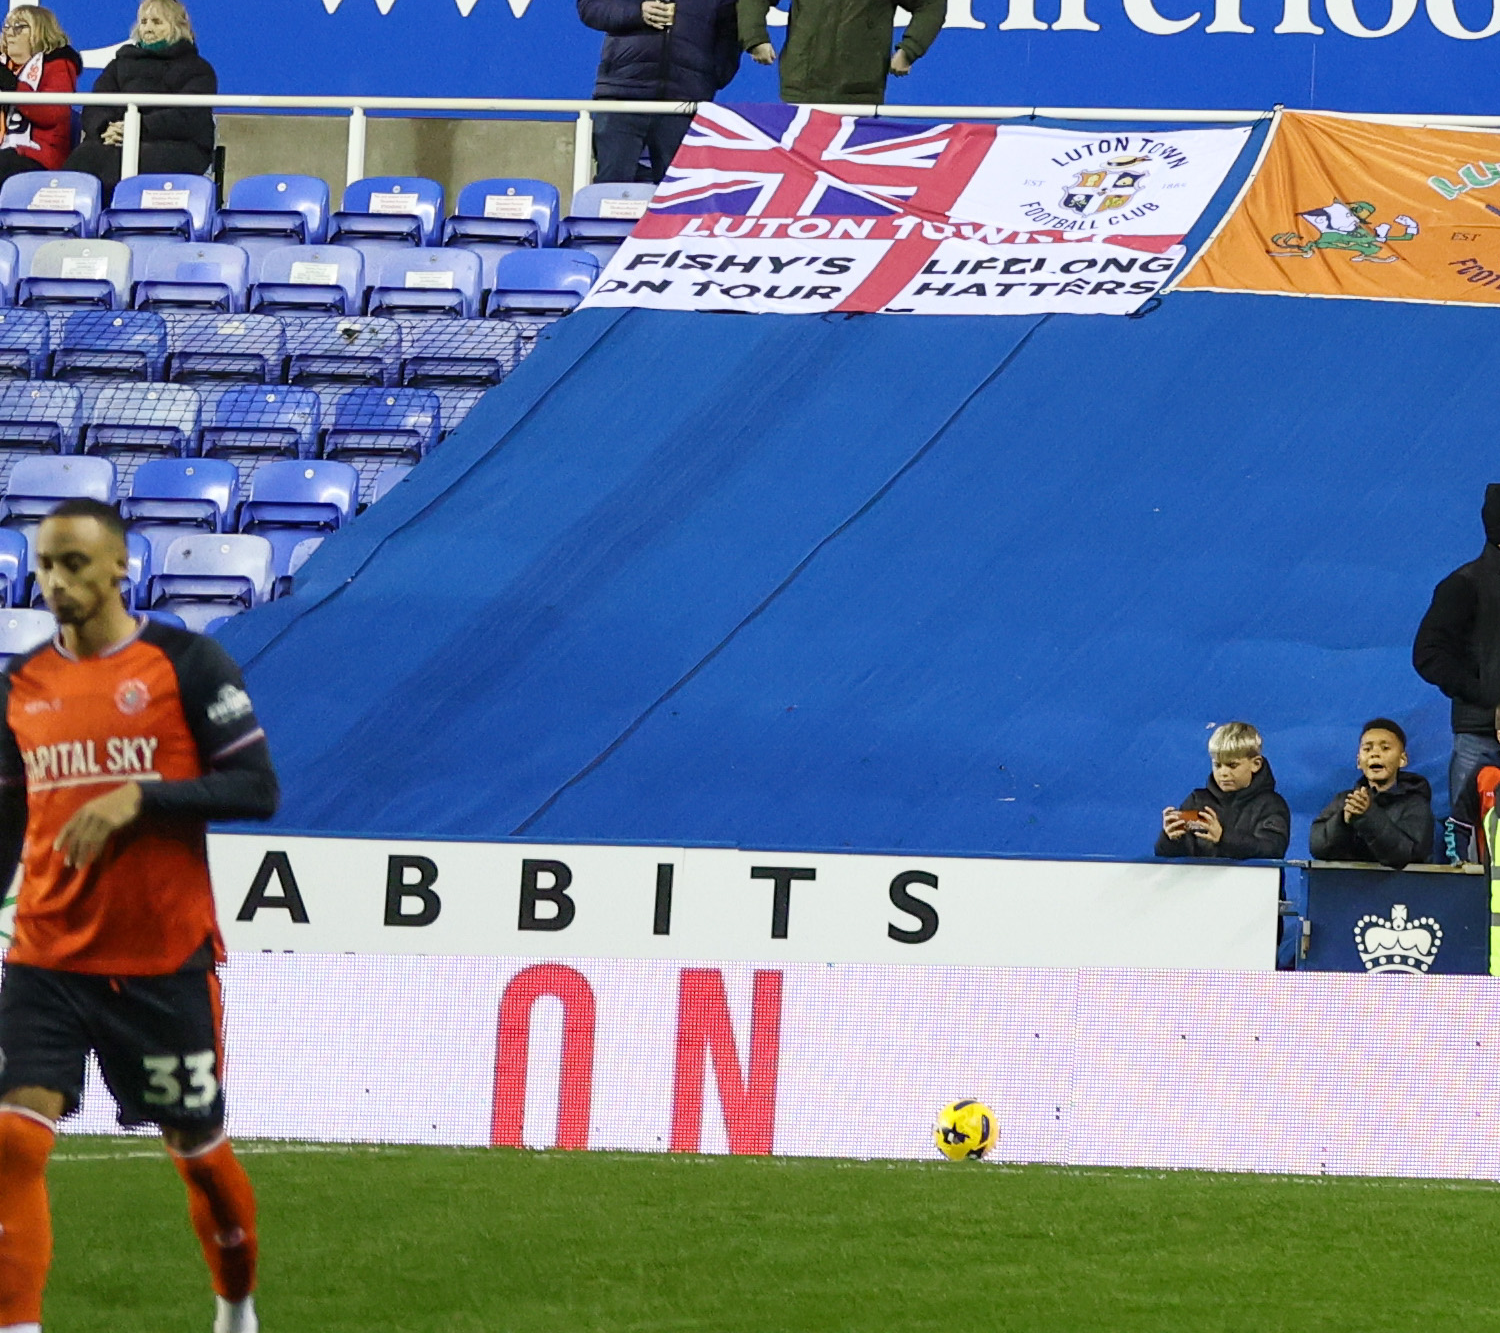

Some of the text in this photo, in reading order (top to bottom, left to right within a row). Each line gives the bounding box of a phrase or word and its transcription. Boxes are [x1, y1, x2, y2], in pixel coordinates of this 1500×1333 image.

[1051, 136, 1190, 171] LUTON TOWN
[684, 217, 877, 241] LUTON
[1020, 200, 1161, 232] FOOTBALL CLUB
[1450, 231, 1482, 242] EST
[622, 249, 856, 277] FISHY'S
[703, 281, 843, 302] TOUR
[913, 278, 1163, 300] HATTERS
[106, 735, 159, 772] SKY
[236, 849, 942, 945] ABBITS
[489, 962, 784, 1157] ON
[141, 1047, 219, 1110] 33
